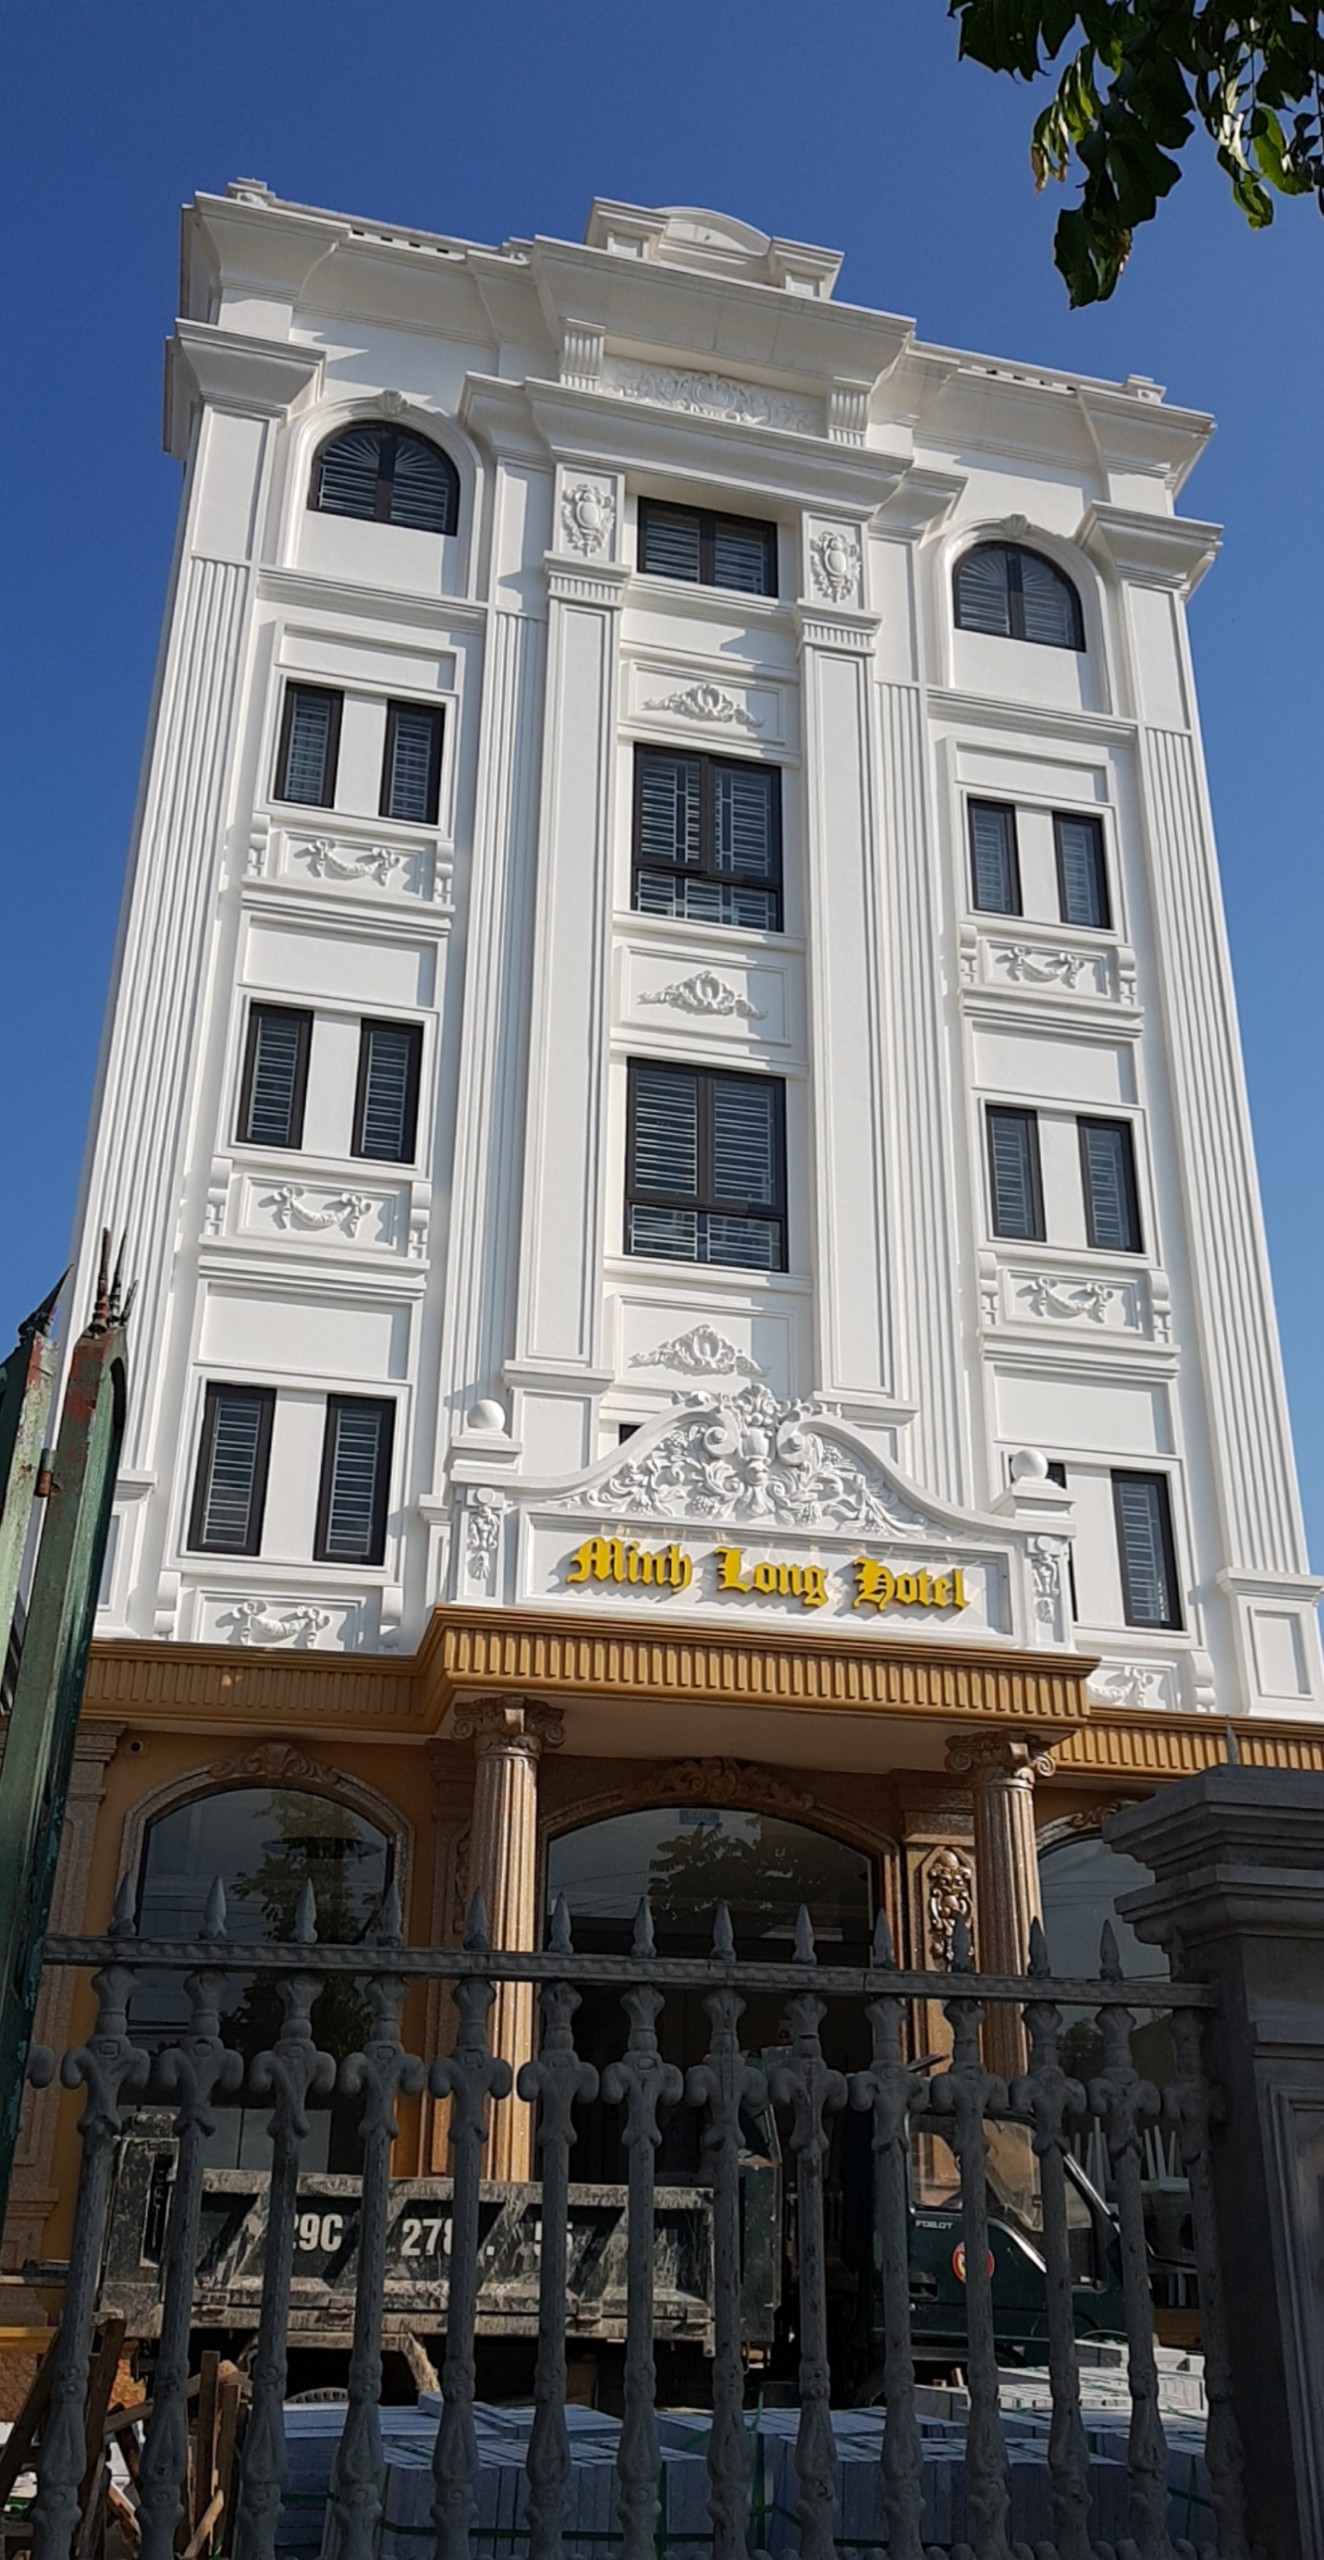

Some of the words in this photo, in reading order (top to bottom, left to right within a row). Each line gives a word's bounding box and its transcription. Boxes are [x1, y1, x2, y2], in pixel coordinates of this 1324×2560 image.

[567, 1537, 692, 1593] Minh
[713, 1545, 829, 1607] Long
[853, 1557, 970, 1612] Hotel
